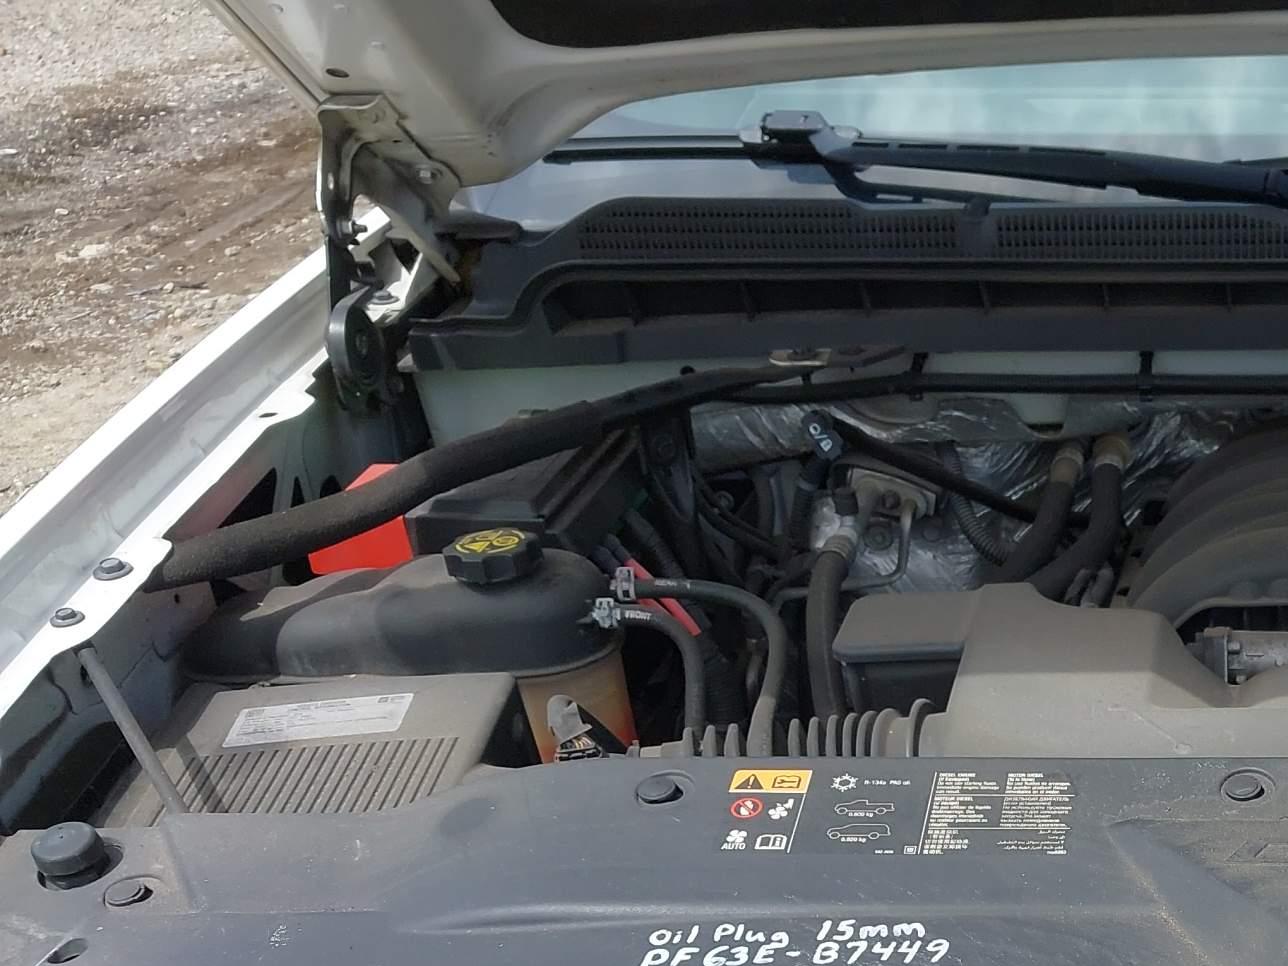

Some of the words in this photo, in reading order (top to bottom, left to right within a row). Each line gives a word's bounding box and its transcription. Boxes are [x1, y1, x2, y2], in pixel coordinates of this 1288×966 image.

[721, 842, 747, 850] AUTO
[713, 924, 789, 948] Plug
[816, 919, 925, 941] 15mm
